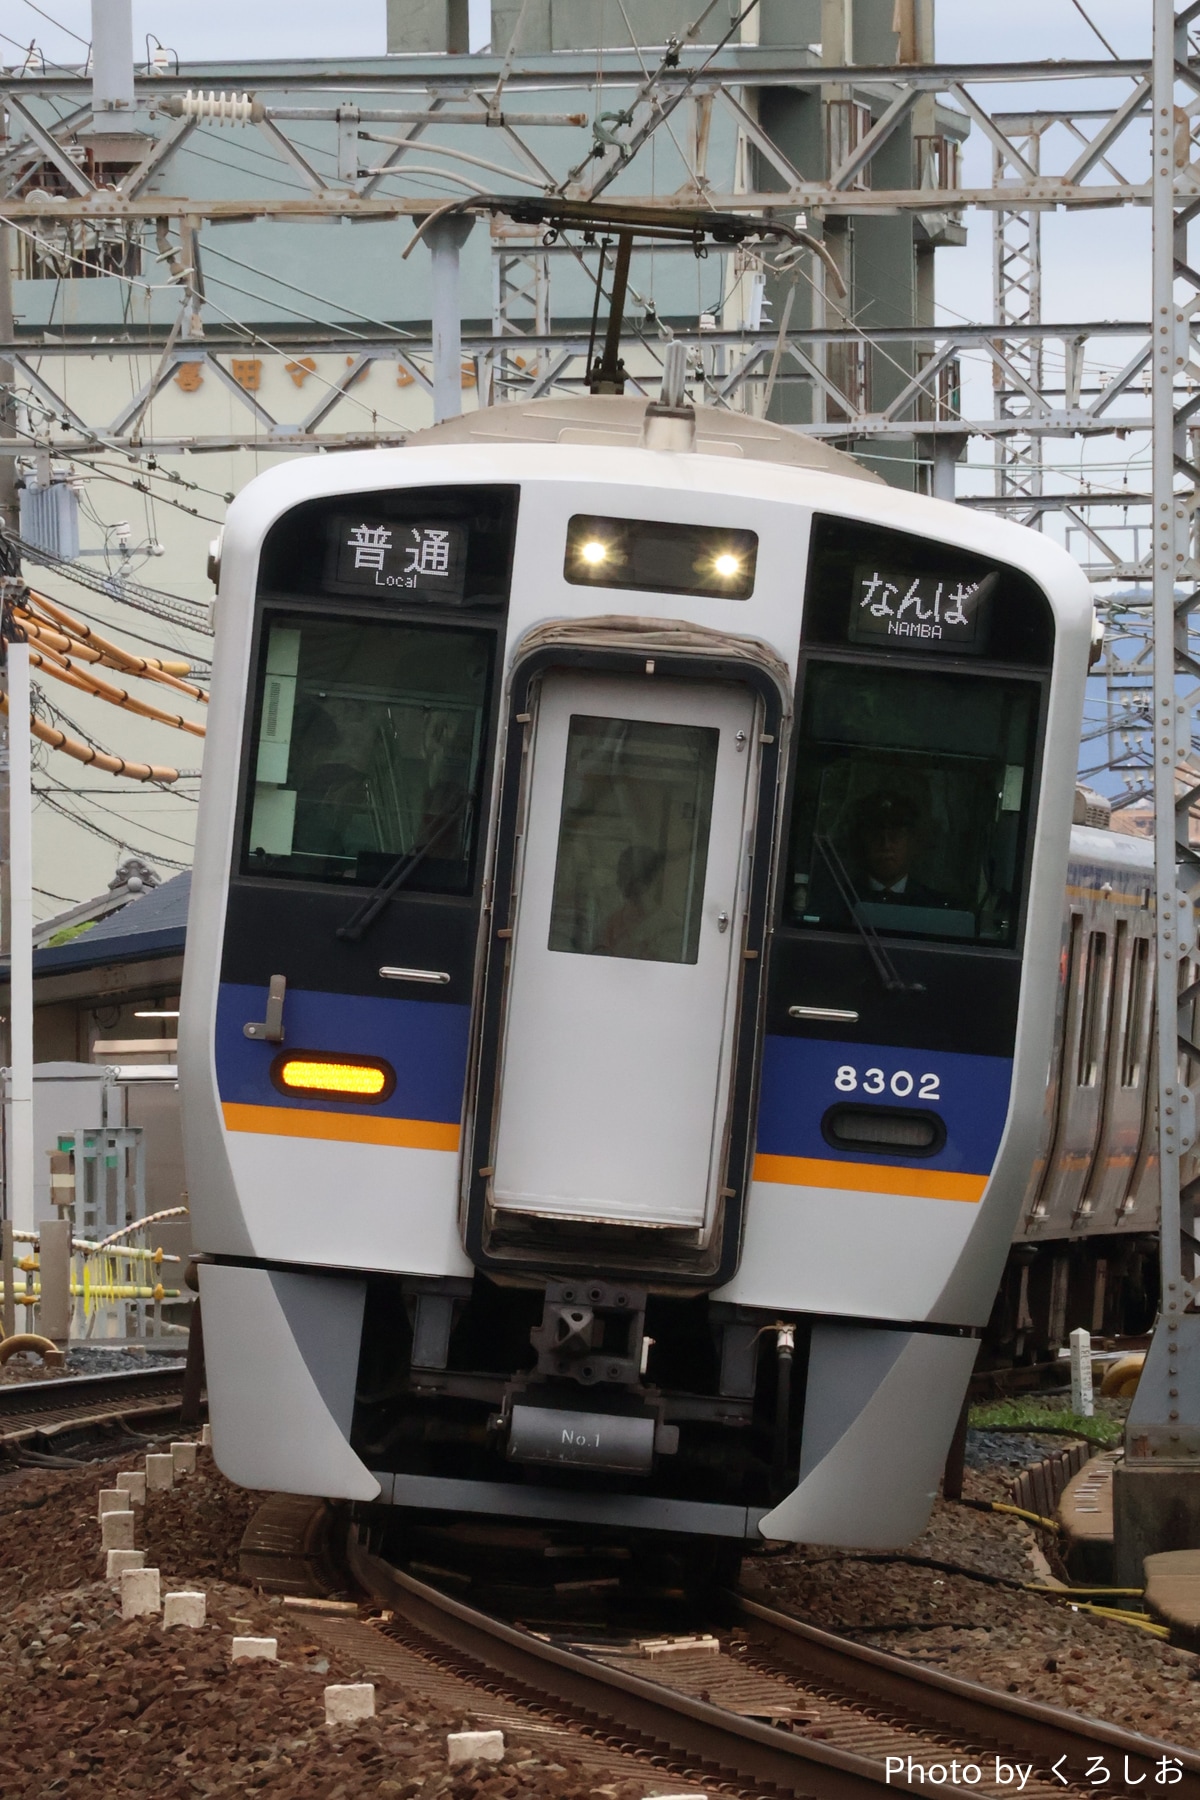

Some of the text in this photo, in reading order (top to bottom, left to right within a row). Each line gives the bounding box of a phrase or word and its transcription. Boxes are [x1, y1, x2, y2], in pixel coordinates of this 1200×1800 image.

[347, 523, 449, 576] 普通
[375, 570, 417, 588] Local
[860, 572, 980, 625] なんば
[887, 620, 943, 639] NAMBA
[834, 1065, 940, 1100] 8302
[561, 1429, 600, 1448] No.1
